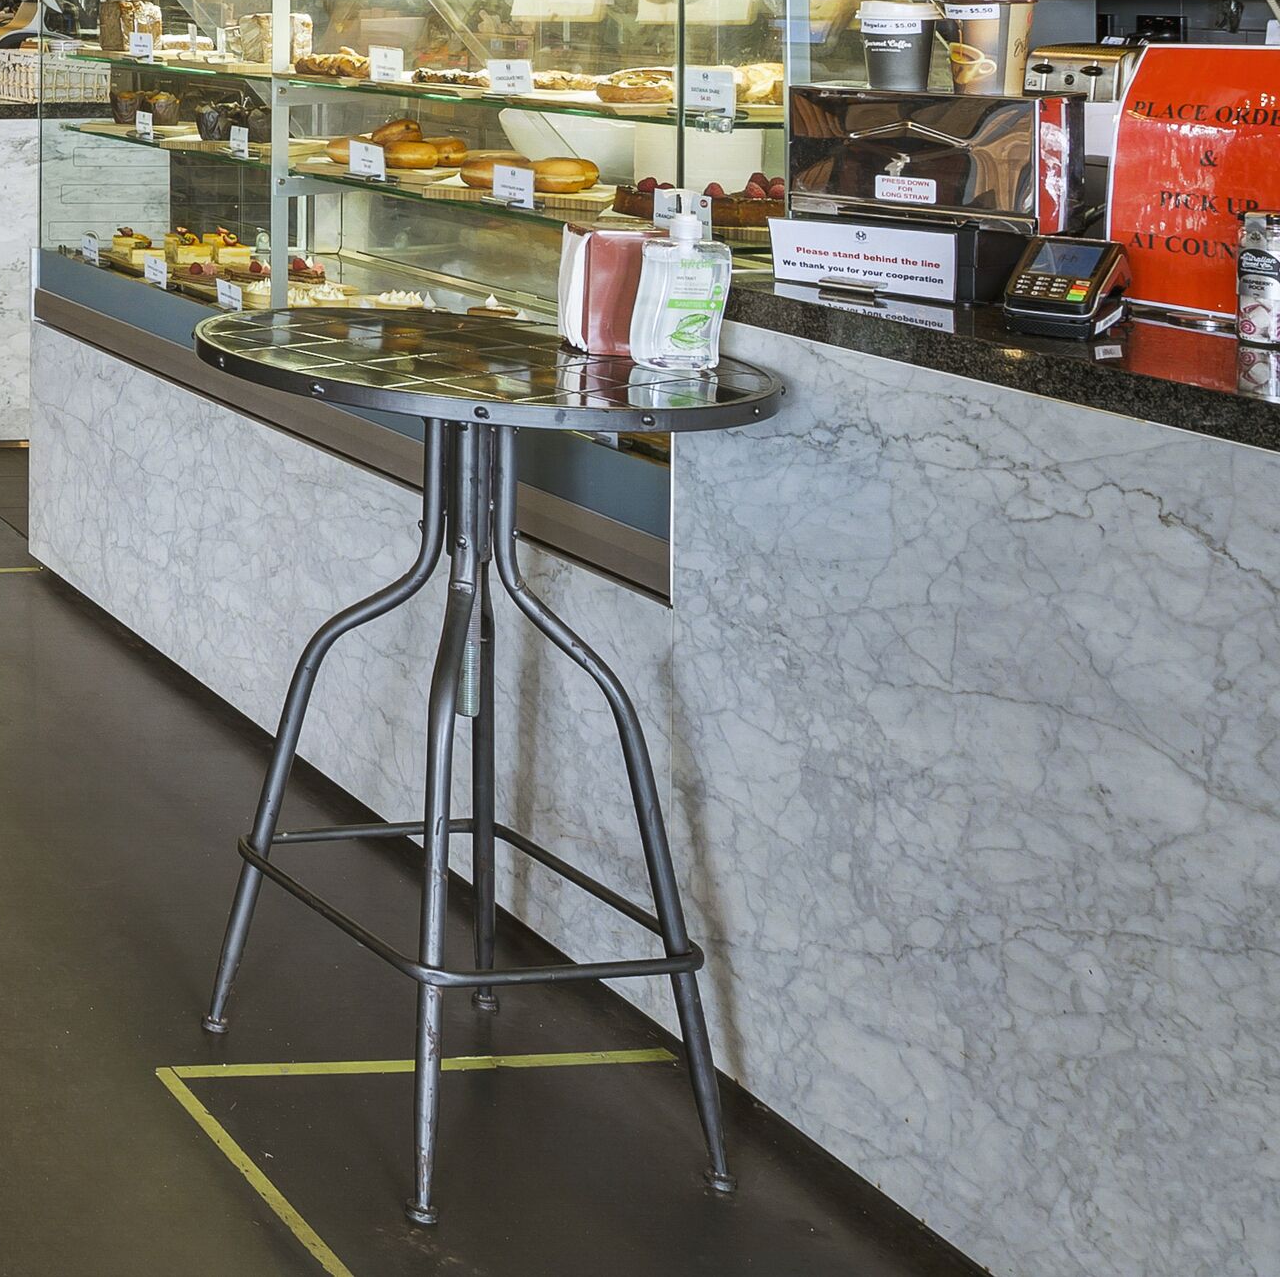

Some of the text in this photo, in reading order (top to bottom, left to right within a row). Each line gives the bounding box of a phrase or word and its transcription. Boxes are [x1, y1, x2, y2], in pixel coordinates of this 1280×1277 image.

[948, 7, 963, 15] Large
[864, 21, 887, 29] Regular
[888, 39, 912, 49] Coffee
[1134, 101, 1210, 121] PLACE
[1199, 150, 1218, 167] &
[881, 178, 906, 186] PRESS
[903, 193, 930, 201] STRAW
[1160, 191, 1259, 217] PICK UP
[1130, 233, 1156, 250] AT
[795, 246, 941, 269] Please stand behind the line
[782, 259, 944, 284] We thank you for your cooperation
